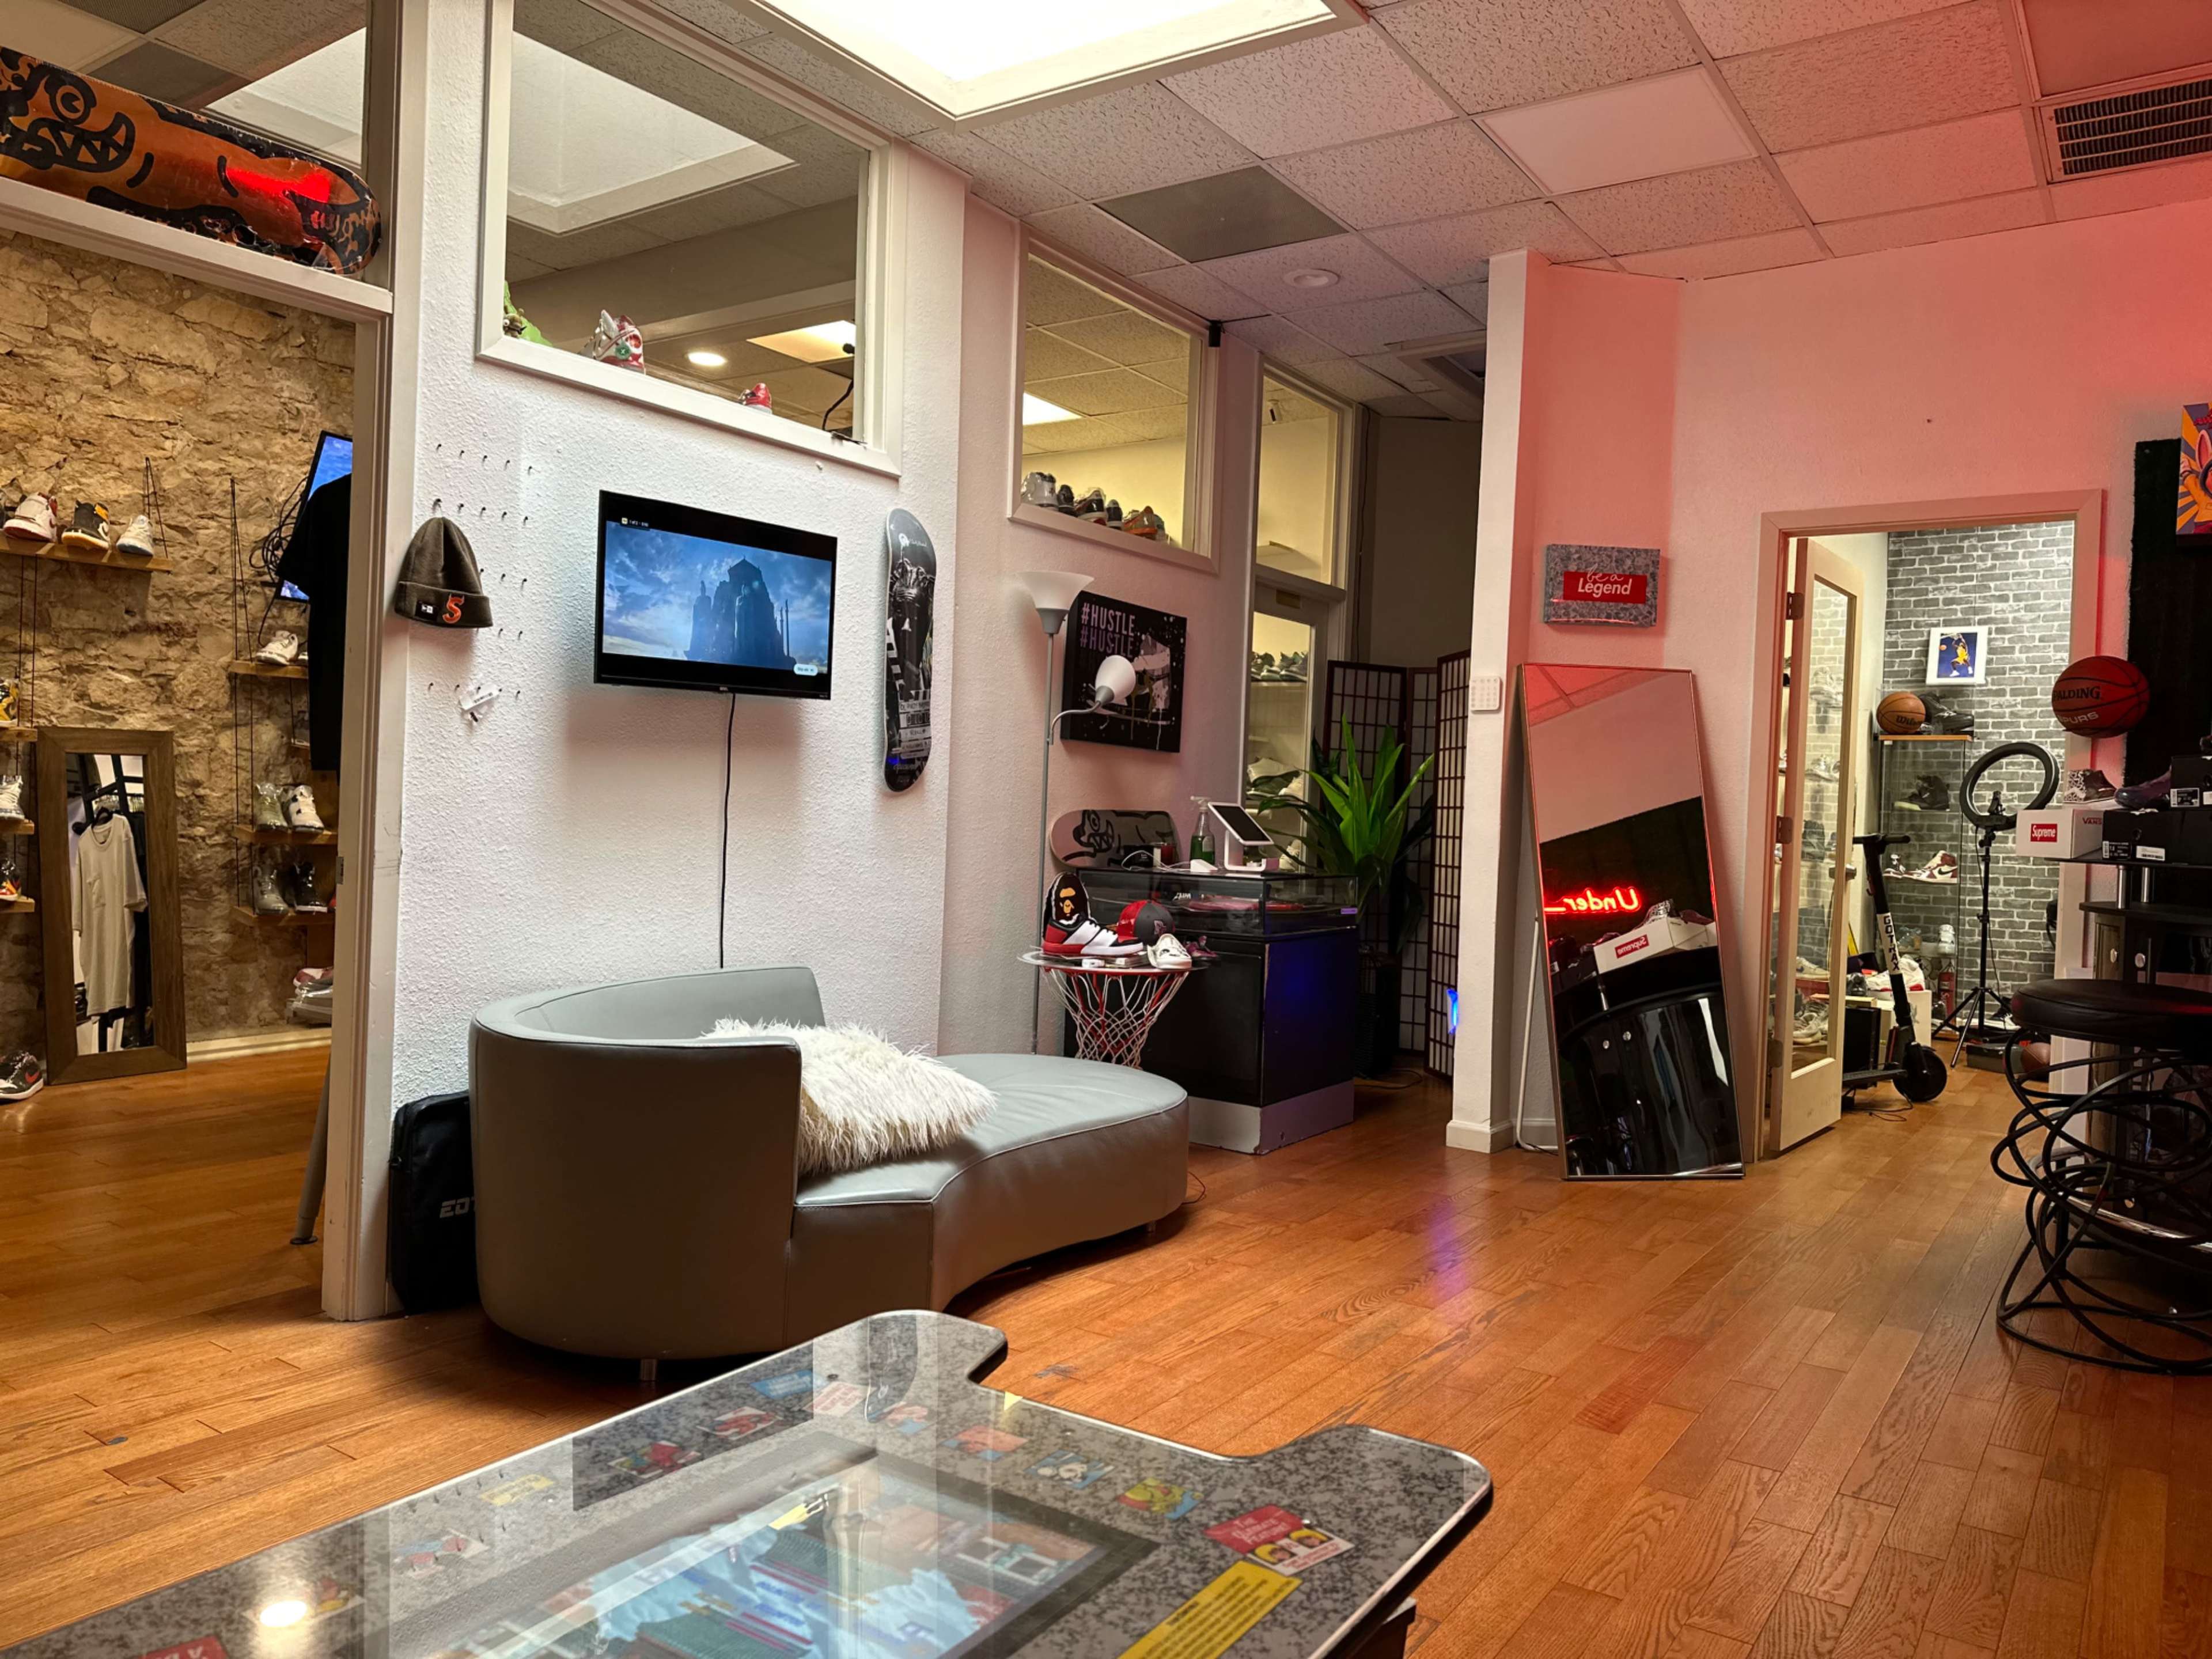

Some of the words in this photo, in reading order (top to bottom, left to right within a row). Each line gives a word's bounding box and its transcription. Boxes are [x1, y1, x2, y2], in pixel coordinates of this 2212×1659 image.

[1585, 562, 1609, 582] be
[1610, 573, 1624, 581] a
[1578, 577, 1633, 598] Legend
[1081, 602, 1135, 636] #HUSTLE
[1080, 626, 1134, 658] #HUSTLE
[2052, 686, 2101, 701] PALDING
[1896, 715, 1923, 726] Wils
[2032, 825, 2056, 840] Supreme
